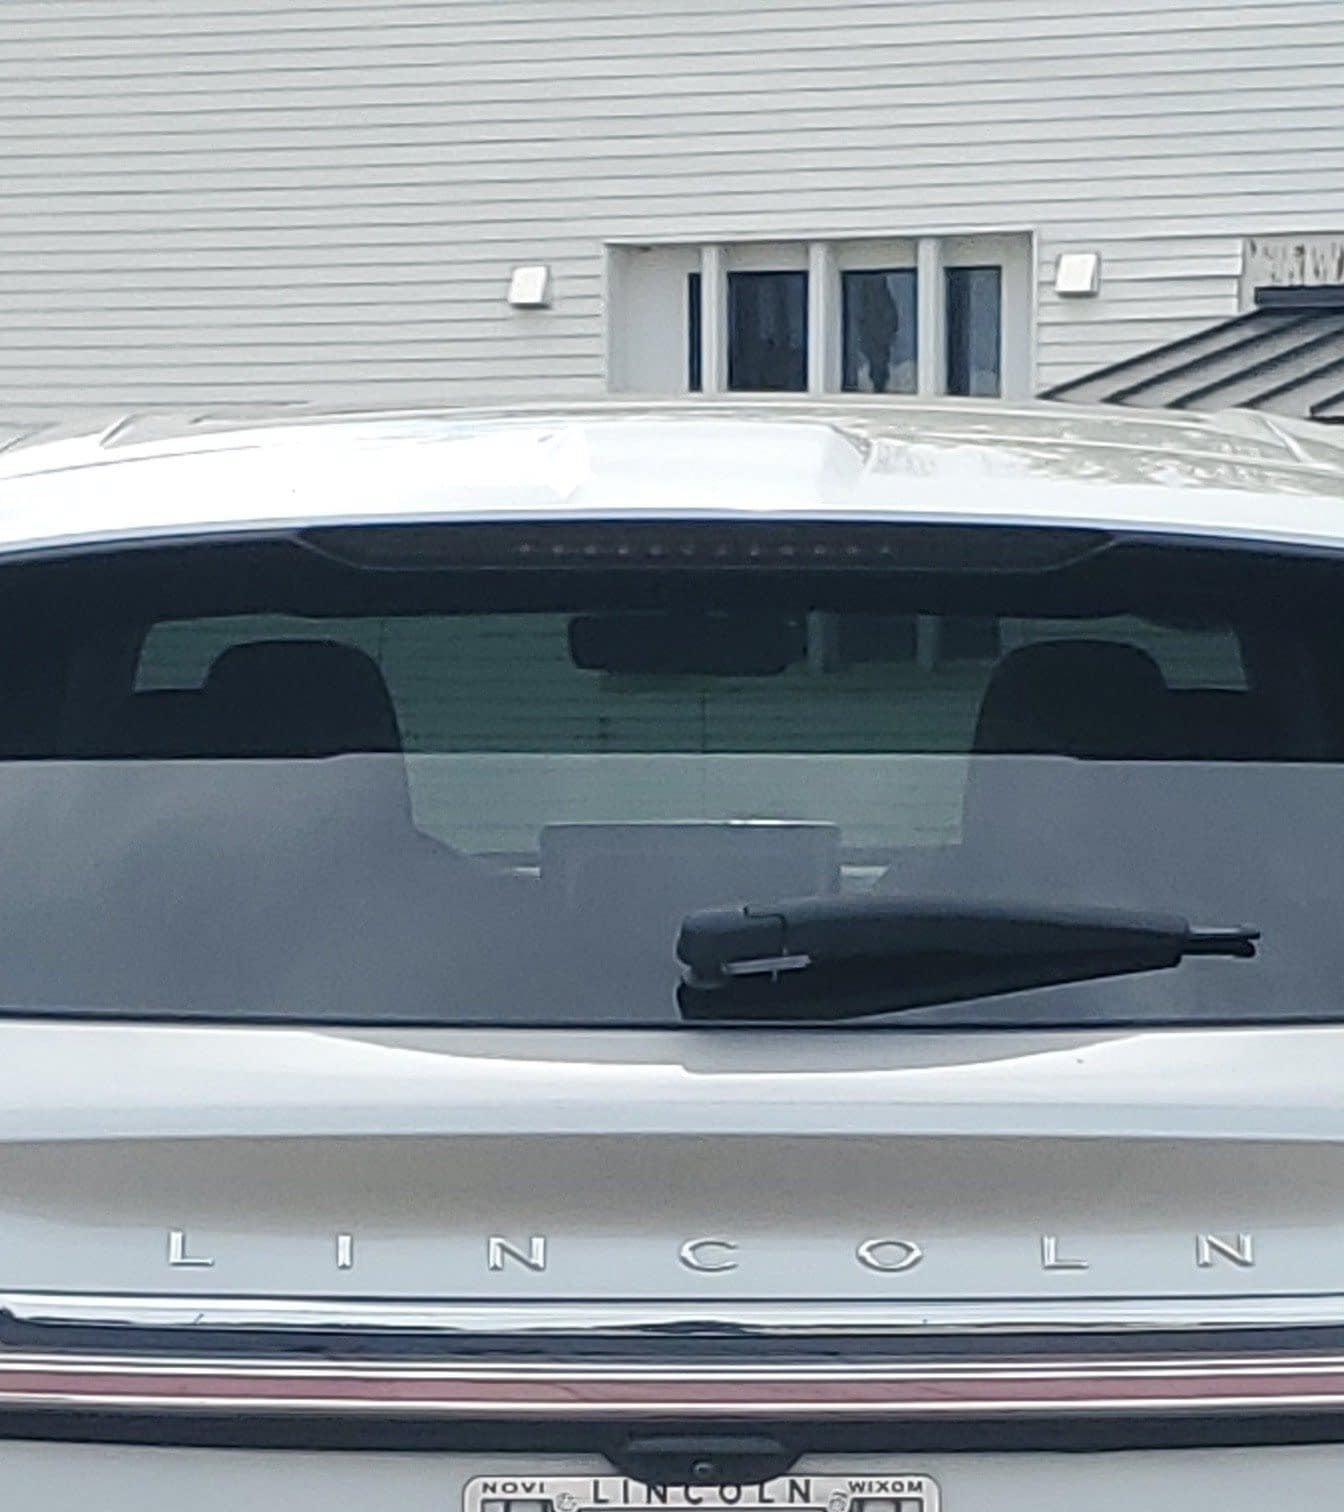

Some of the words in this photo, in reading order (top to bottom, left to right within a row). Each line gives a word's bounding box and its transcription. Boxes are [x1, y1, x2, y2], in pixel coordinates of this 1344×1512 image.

[169, 1231, 1255, 1270] LINCOLN
[482, 1482, 545, 1494] NOVI
[593, 1479, 811, 1505] LINCOLN
[849, 1480, 923, 1493] WIXOM
